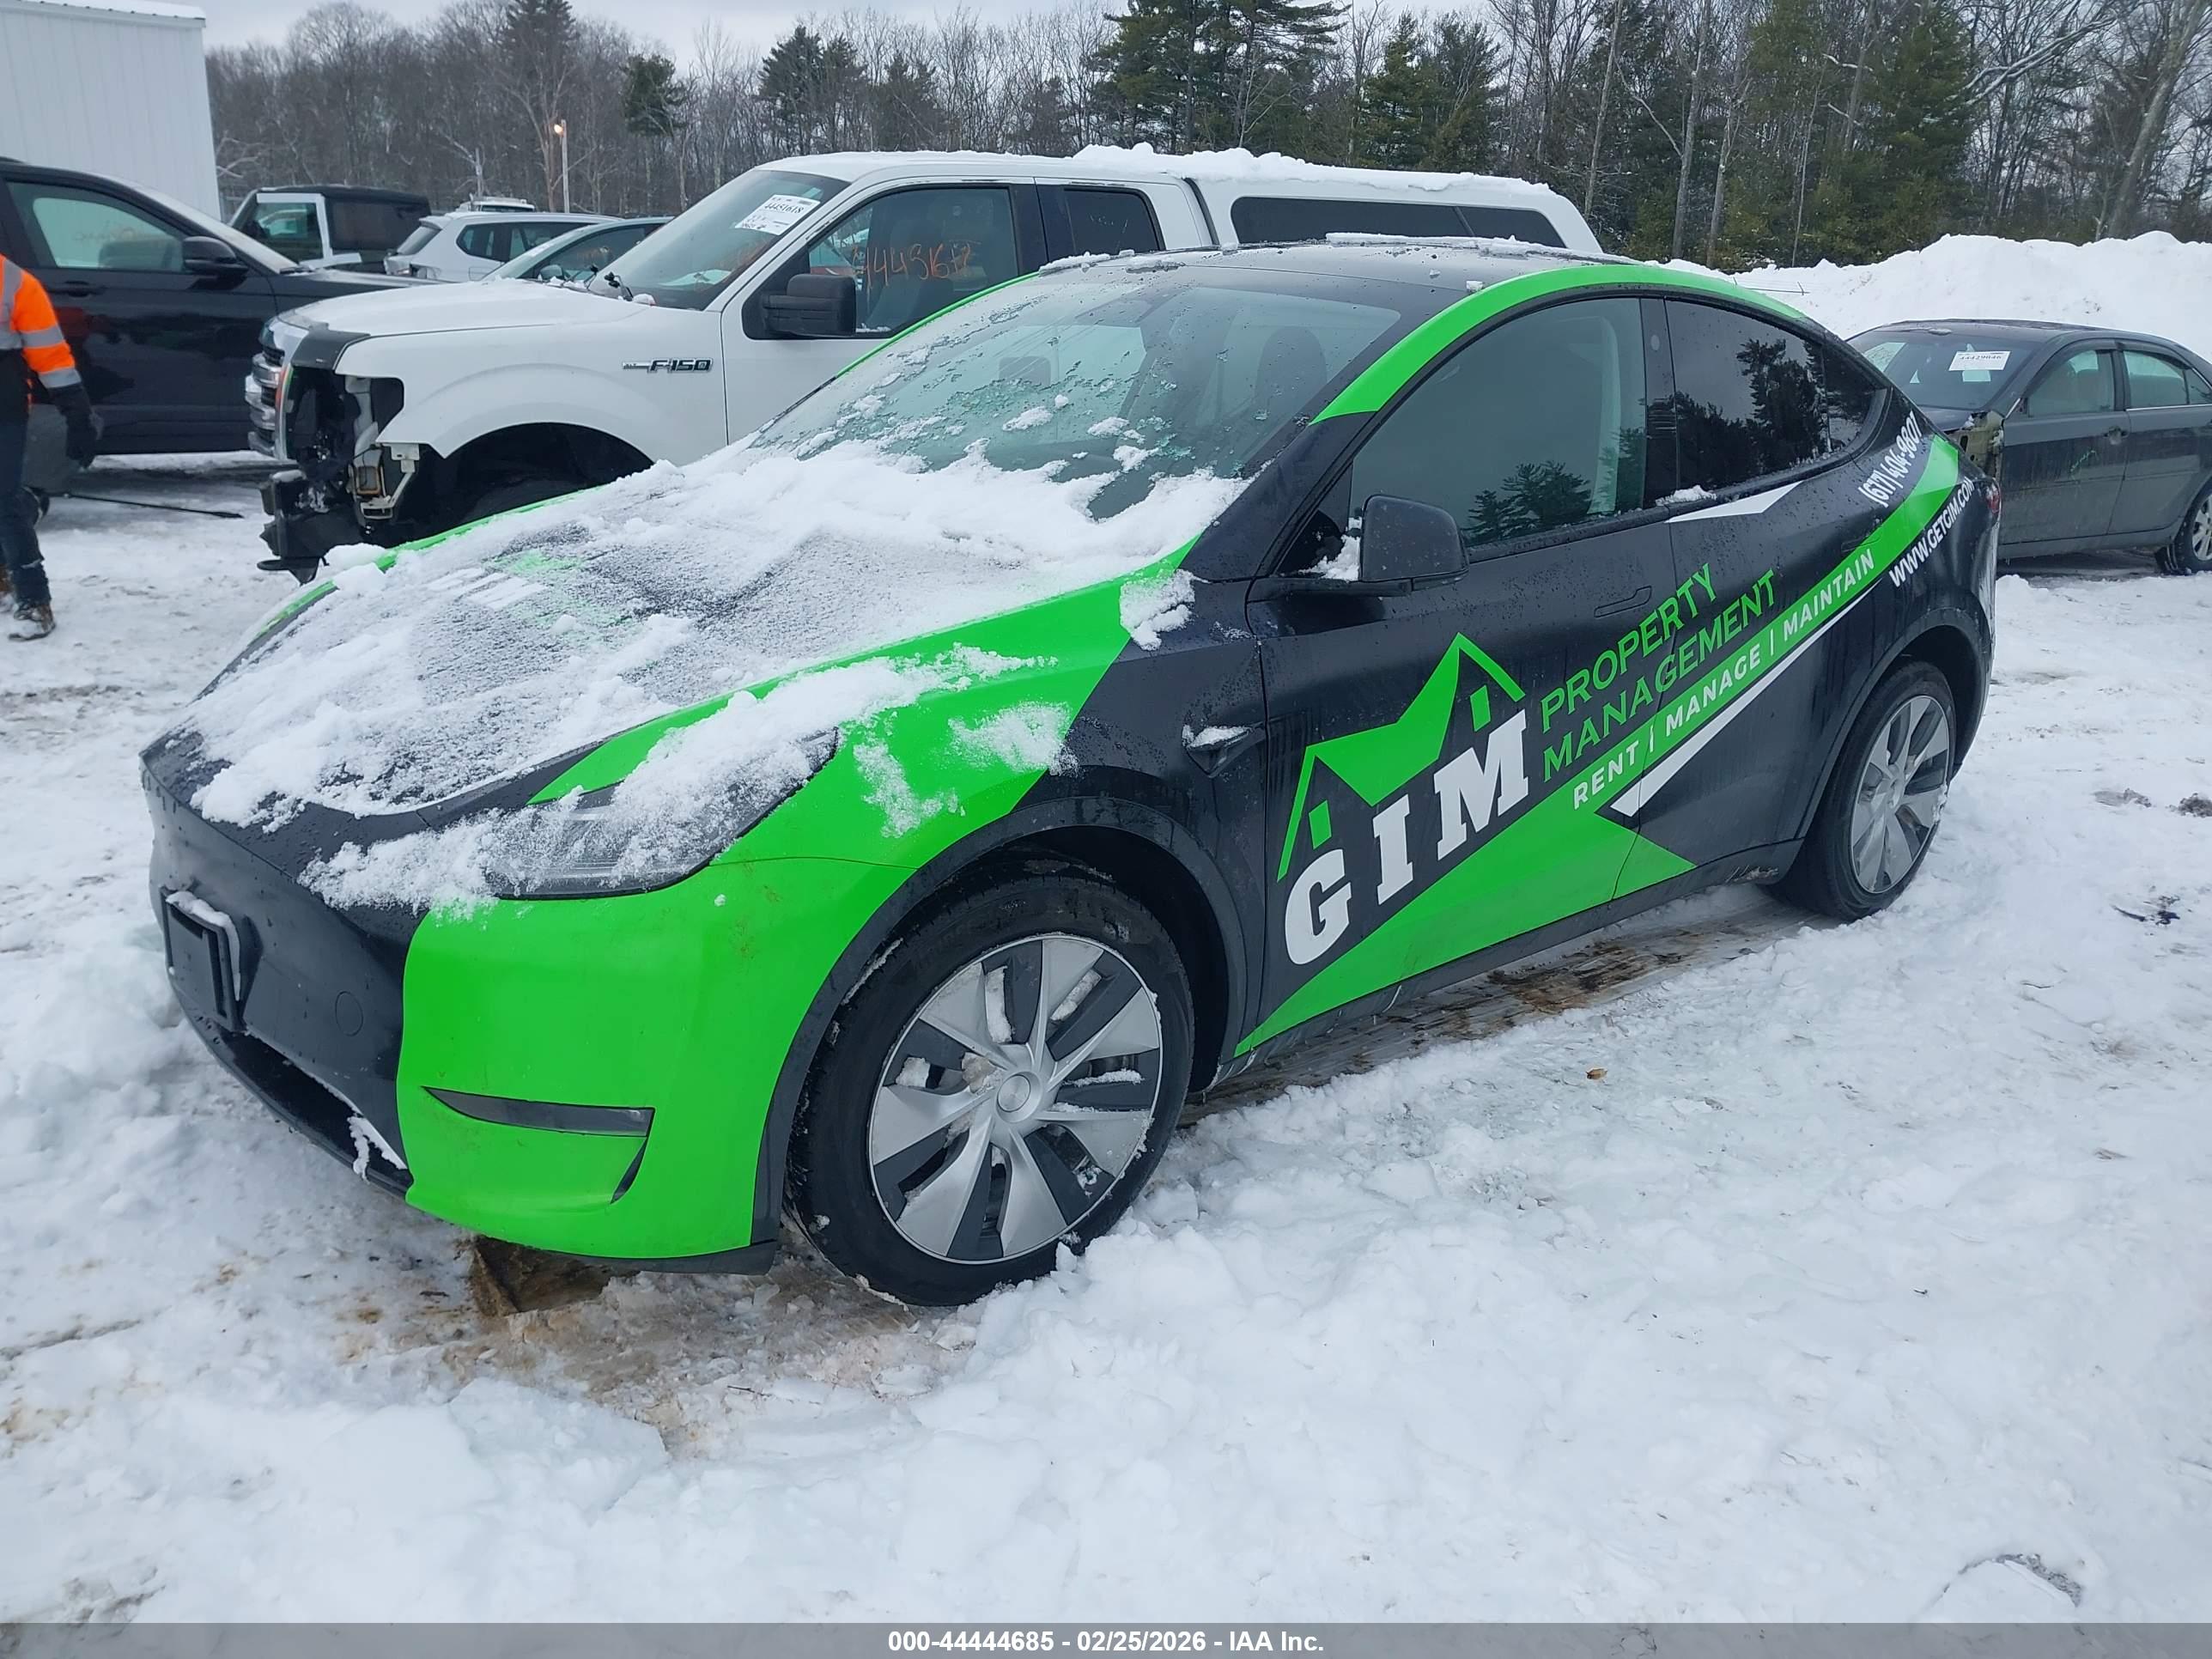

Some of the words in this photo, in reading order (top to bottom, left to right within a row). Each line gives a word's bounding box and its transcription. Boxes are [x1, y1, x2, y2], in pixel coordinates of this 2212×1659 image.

[1884, 410, 1923, 478] 404-9801
[1888, 476, 1975, 588] WWW.GETGIM.COM
[1540, 562, 1717, 734] PROPERTY
[1543, 569, 1774, 782] MANAGEMENT
[1573, 740, 1640, 811] RENT
[1665, 643, 1760, 737] MANAGE
[1784, 548, 1875, 641] MAINTAIN
[1285, 708, 1529, 965] GIM
